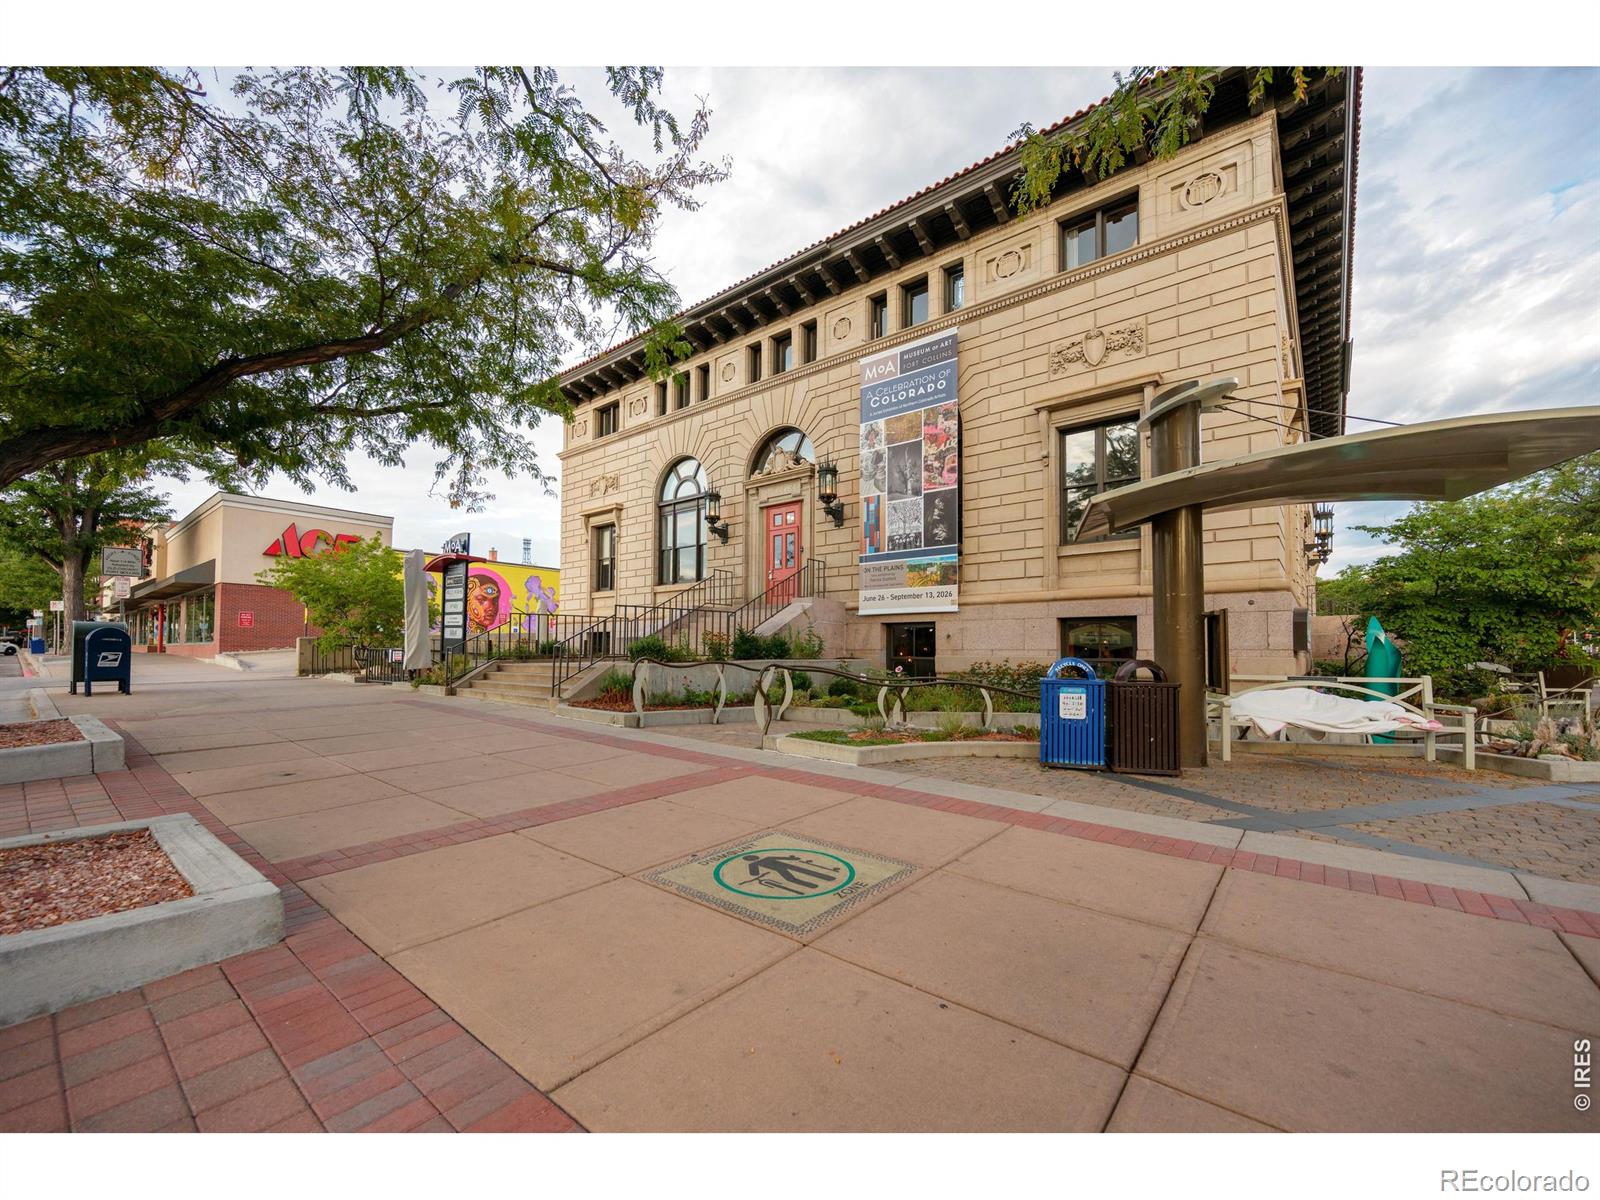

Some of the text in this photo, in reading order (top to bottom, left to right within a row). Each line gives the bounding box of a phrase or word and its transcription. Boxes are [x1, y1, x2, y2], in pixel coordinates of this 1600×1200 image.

[903, 347, 931, 360] MUSEUM
[940, 339, 952, 348] ART
[903, 350, 953, 369] FORT COLLINS
[864, 360, 896, 381] MoA
[865, 368, 951, 400] A CELEBRATION OF
[870, 380, 946, 408] COLORADO
[890, 592, 923, 601] September
[925, 591, 935, 599] 13,
[936, 590, 953, 598] 2026
[832, 881, 868, 898] ZONE
